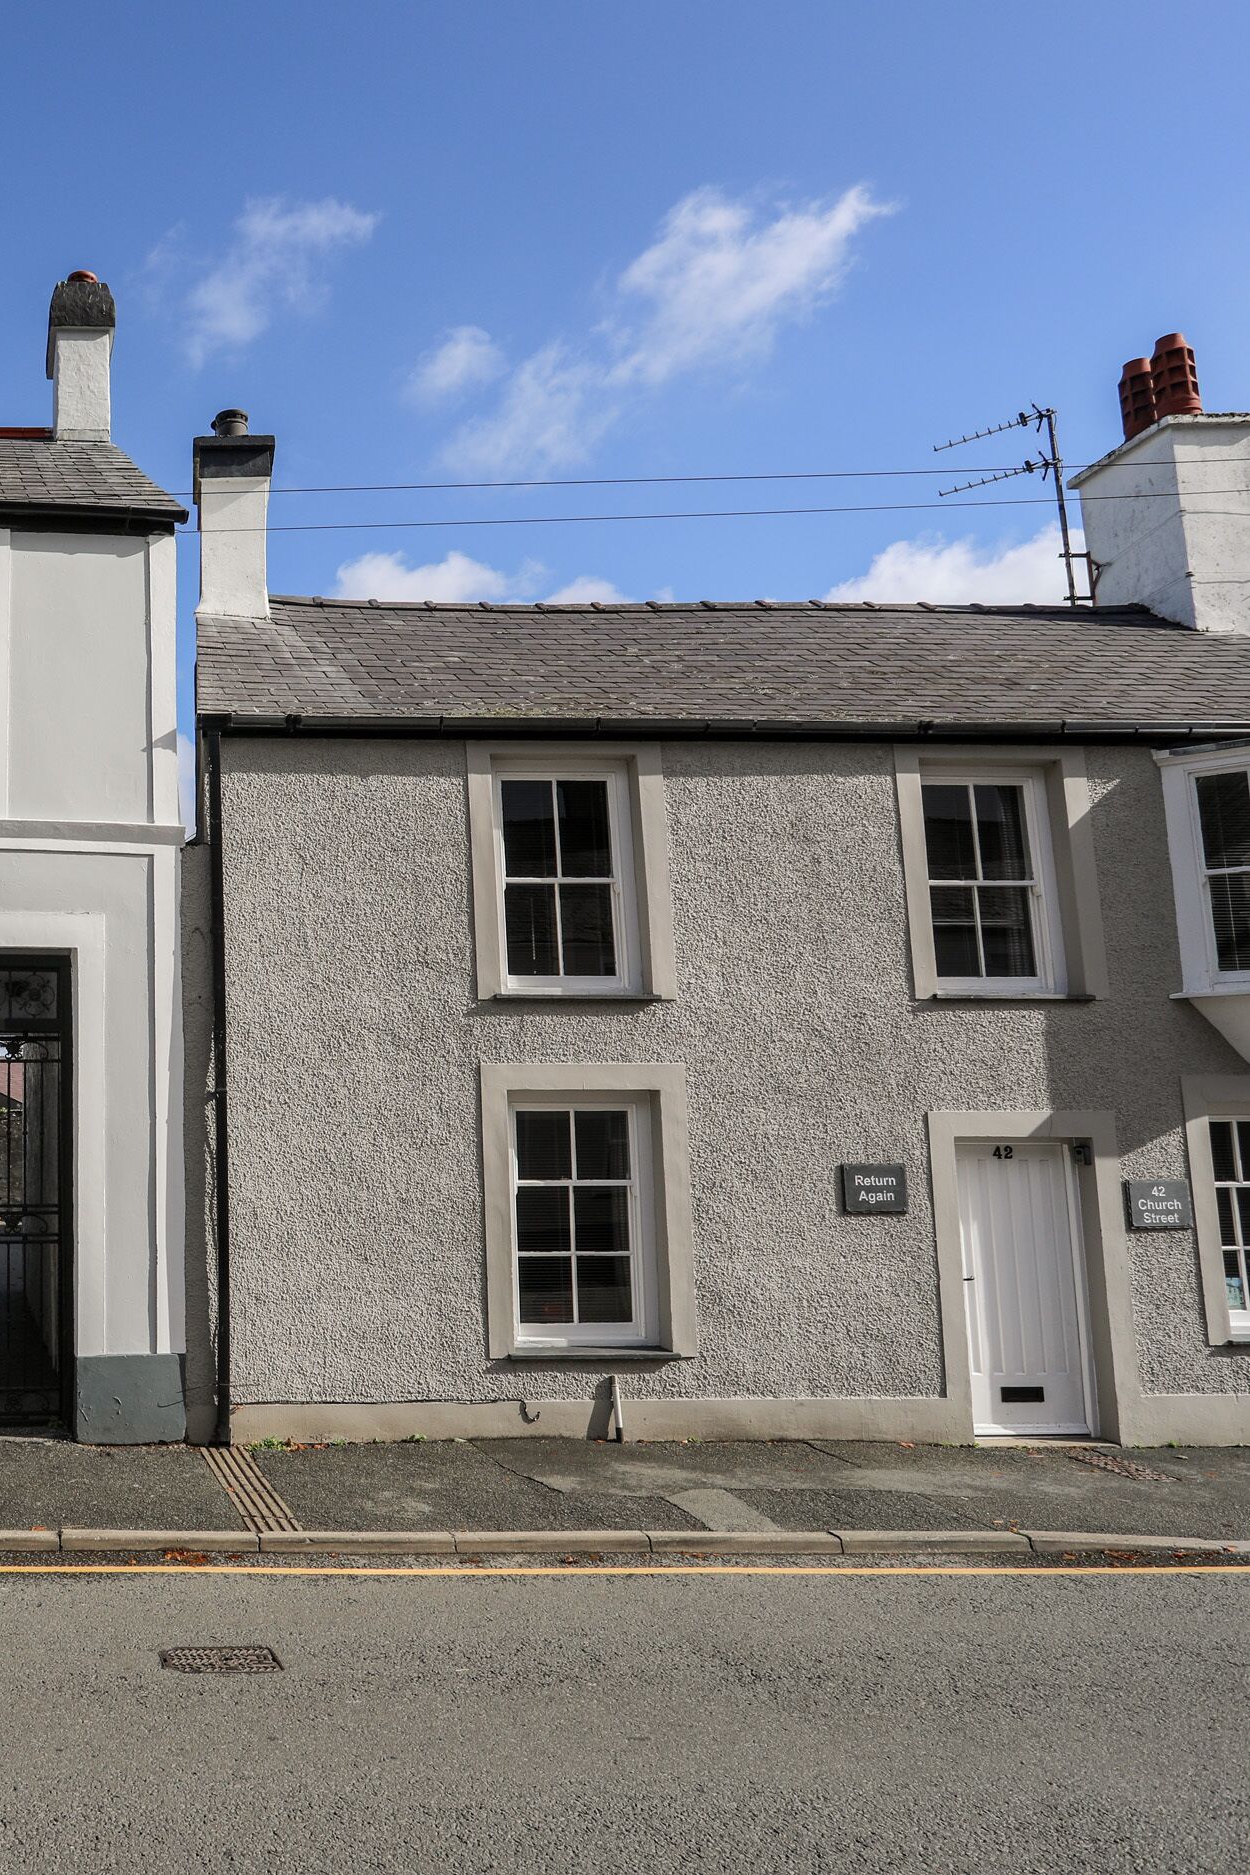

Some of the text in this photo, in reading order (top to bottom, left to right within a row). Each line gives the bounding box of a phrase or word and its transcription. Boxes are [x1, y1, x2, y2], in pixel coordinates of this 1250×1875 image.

[992, 1145, 1013, 1160] 42
[854, 1174, 897, 1186] Return
[858, 1190, 895, 1204] Again
[1151, 1186, 1166, 1197] 42
[1138, 1199, 1182, 1210] Church
[1143, 1212, 1180, 1223] Street
